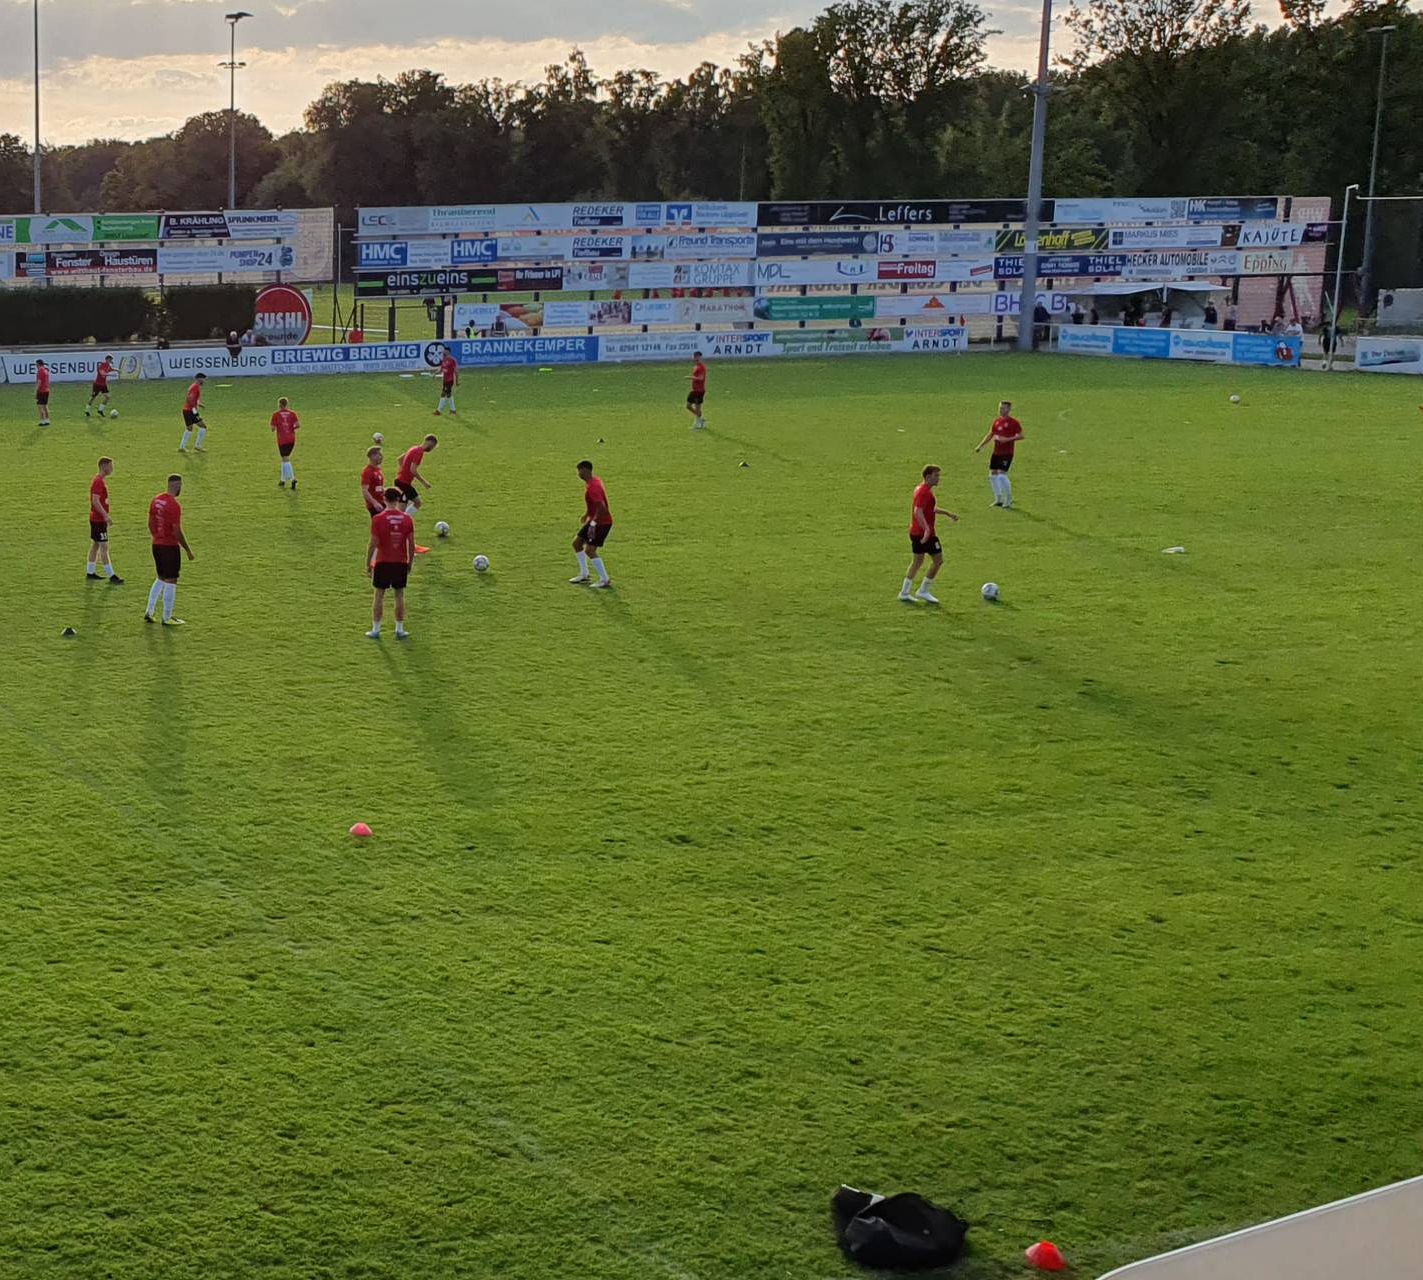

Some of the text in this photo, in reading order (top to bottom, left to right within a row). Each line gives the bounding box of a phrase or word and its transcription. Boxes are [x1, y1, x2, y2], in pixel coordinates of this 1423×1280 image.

[572, 205, 624, 216] REDEKER
[572, 237, 624, 247] REDEKER
[1242, 228, 1299, 245] KAJÜTE
[361, 245, 403, 260] HMC
[453, 240, 492, 257] HMC
[55, 257, 92, 268] Fenster
[104, 255, 153, 267] Haustüren
[258, 253, 273, 267] 24
[998, 259, 1025, 268] THIE
[1087, 256, 1122, 266] THIEL
[1126, 252, 1209, 268] HECKER AUTOMOBILE
[693, 264, 741, 275] KOMTAX
[897, 262, 935, 277] Freitag
[998, 267, 1025, 276] SOLA
[1088, 264, 1123, 275] SOLAR
[387, 270, 469, 288] einszueins
[693, 274, 736, 285] GRUPPE
[254, 311, 303, 331] SUSHI
[715, 332, 771, 344] INTERSPORT
[914, 327, 967, 338] INTERSPORT
[461, 338, 586, 356] BRANNEKEMPER
[712, 342, 764, 355] ARNDT
[783, 342, 806, 354] Sport
[806, 342, 823, 353] und
[912, 338, 959, 351] ARNDT
[273, 345, 418, 364] BRIEWIG BRIEWIG
[169, 354, 268, 371] WEISSENBURG
